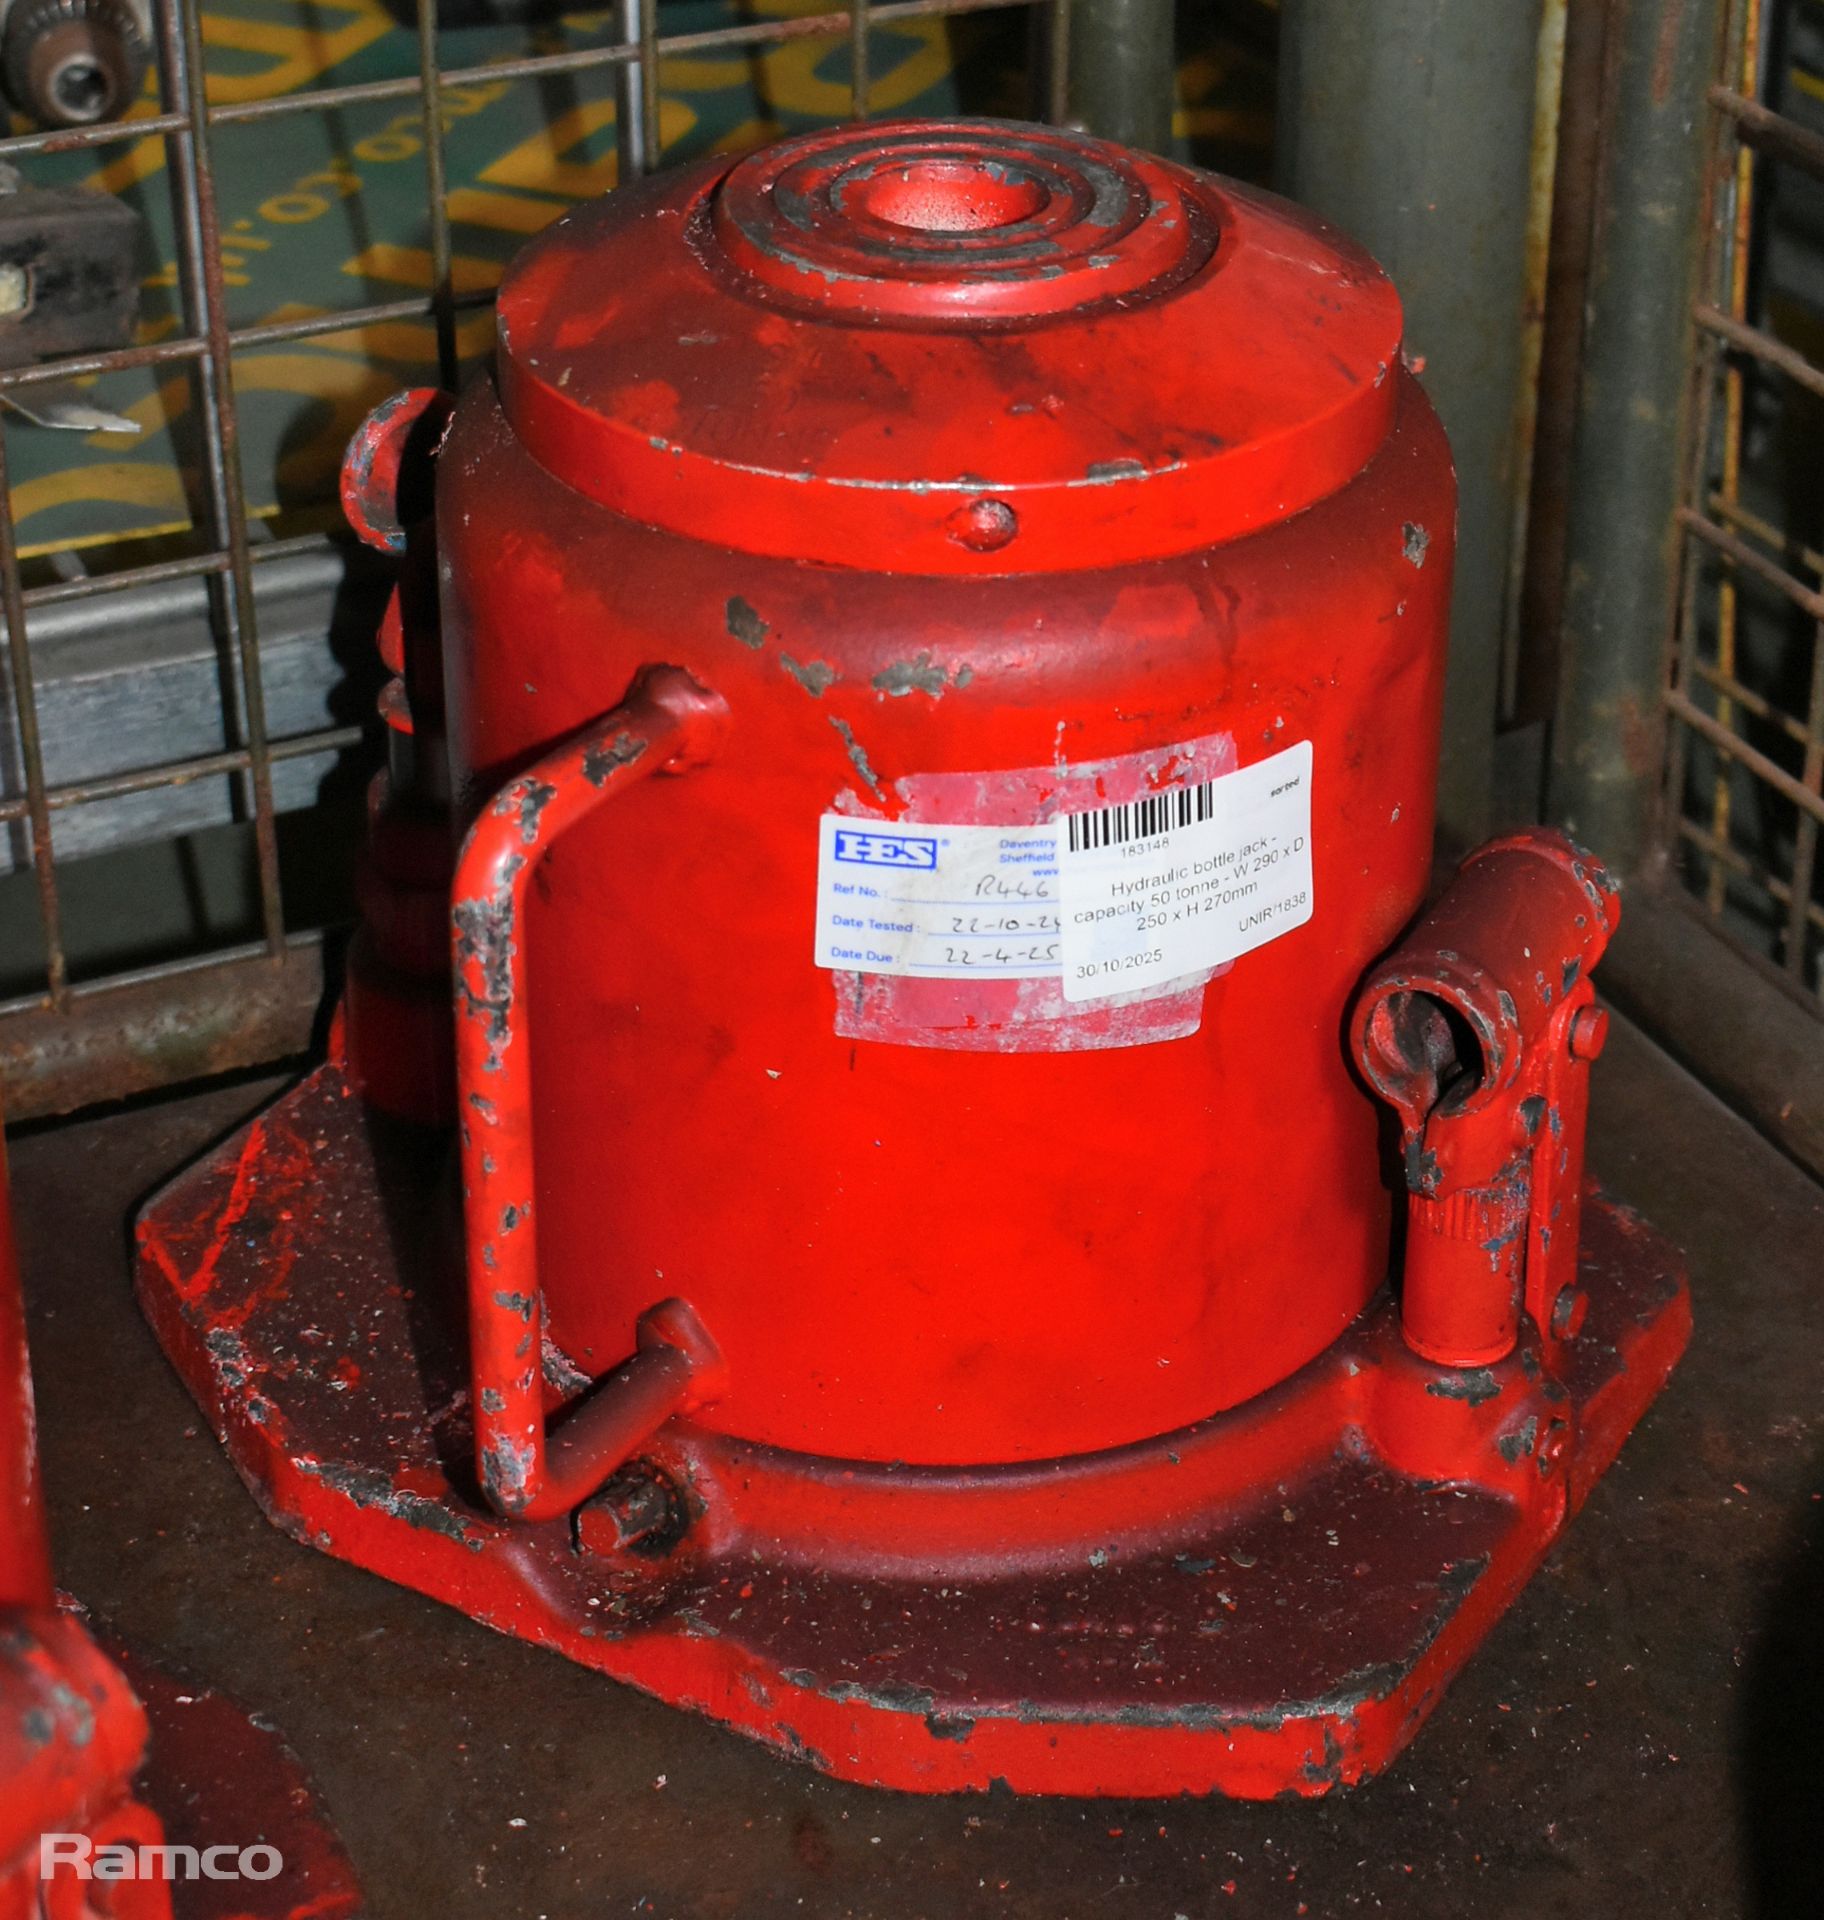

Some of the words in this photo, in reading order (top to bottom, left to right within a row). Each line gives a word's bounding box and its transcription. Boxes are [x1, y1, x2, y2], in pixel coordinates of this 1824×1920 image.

[836, 831, 936, 869] HES
[999, 838, 1057, 850] Daventry
[1121, 838, 1170, 858] 183148
[999, 853, 1055, 863] Sheffield
[1111, 868, 1189, 897] Hydraulic
[1194, 853, 1235, 875] bottle
[1238, 838, 1268, 865] jack
[833, 882, 855, 894] Ref
[1073, 900, 1145, 924] capacity
[1151, 891, 1171, 908] 50
[1176, 879, 1220, 901] tonne
[1234, 862, 1250, 879] W
[1253, 851, 1279, 873] 290
[1283, 846, 1291, 857] x
[1293, 837, 1305, 853] D
[1136, 912, 1168, 932] 250
[1172, 909, 1182, 920] x
[1187, 902, 1199, 917] H
[1204, 880, 1259, 912] 270mm
[1238, 890, 1307, 932] UNIR/1838
[832, 915, 863, 929] Date
[831, 947, 862, 960] Date
[1076, 948, 1163, 979] 30/10/2025
